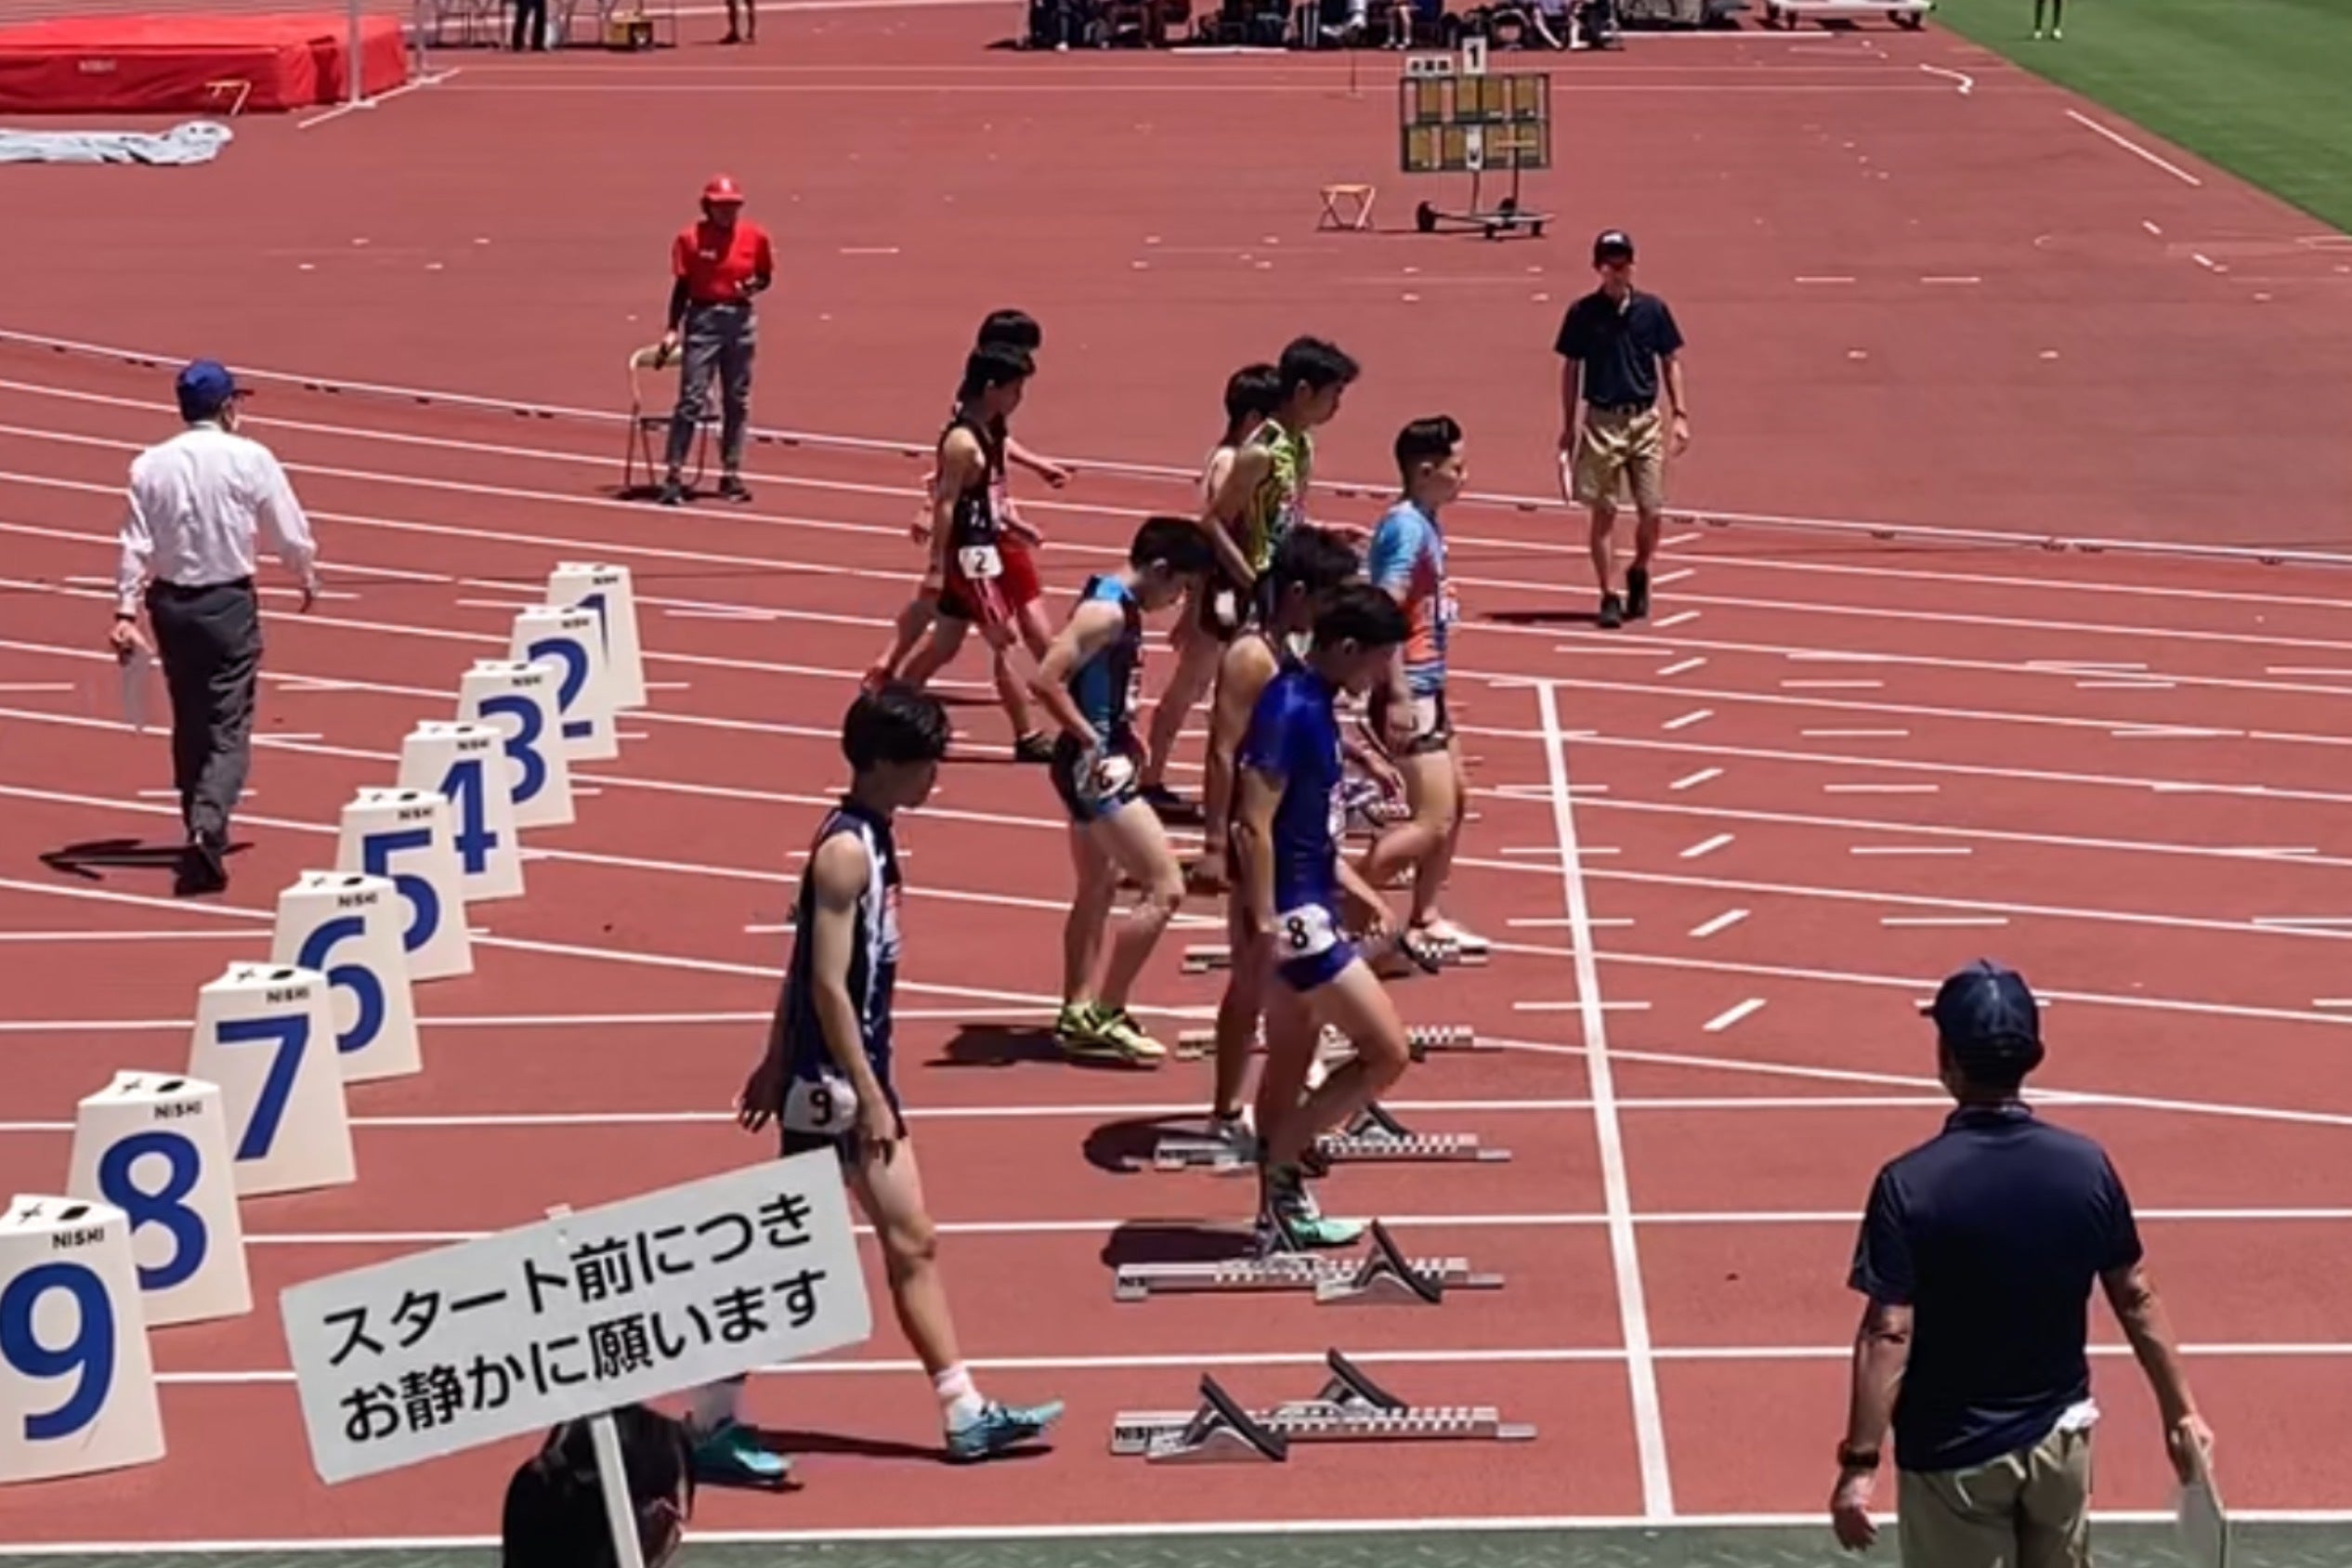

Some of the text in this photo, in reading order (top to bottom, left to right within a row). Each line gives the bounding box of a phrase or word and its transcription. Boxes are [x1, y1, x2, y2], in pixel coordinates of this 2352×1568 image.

[974, 551, 987, 573] 2
[528, 637, 593, 738] 2
[478, 695, 546, 804] 3
[438, 759, 497, 874] 4
[362, 827, 440, 953] 5
[1287, 917, 1308, 949] 8
[297, 915, 385, 1053] 6
[216, 1013, 309, 1161] 7
[809, 1089, 832, 1127] 9
[52, 1227, 104, 1248] NISHI
[98, 1130, 207, 1290] 8
[323, 1193, 812, 1366] スタート前につき
[0, 1261, 114, 1441] 9
[340, 1269, 828, 1444] お静かに願います
